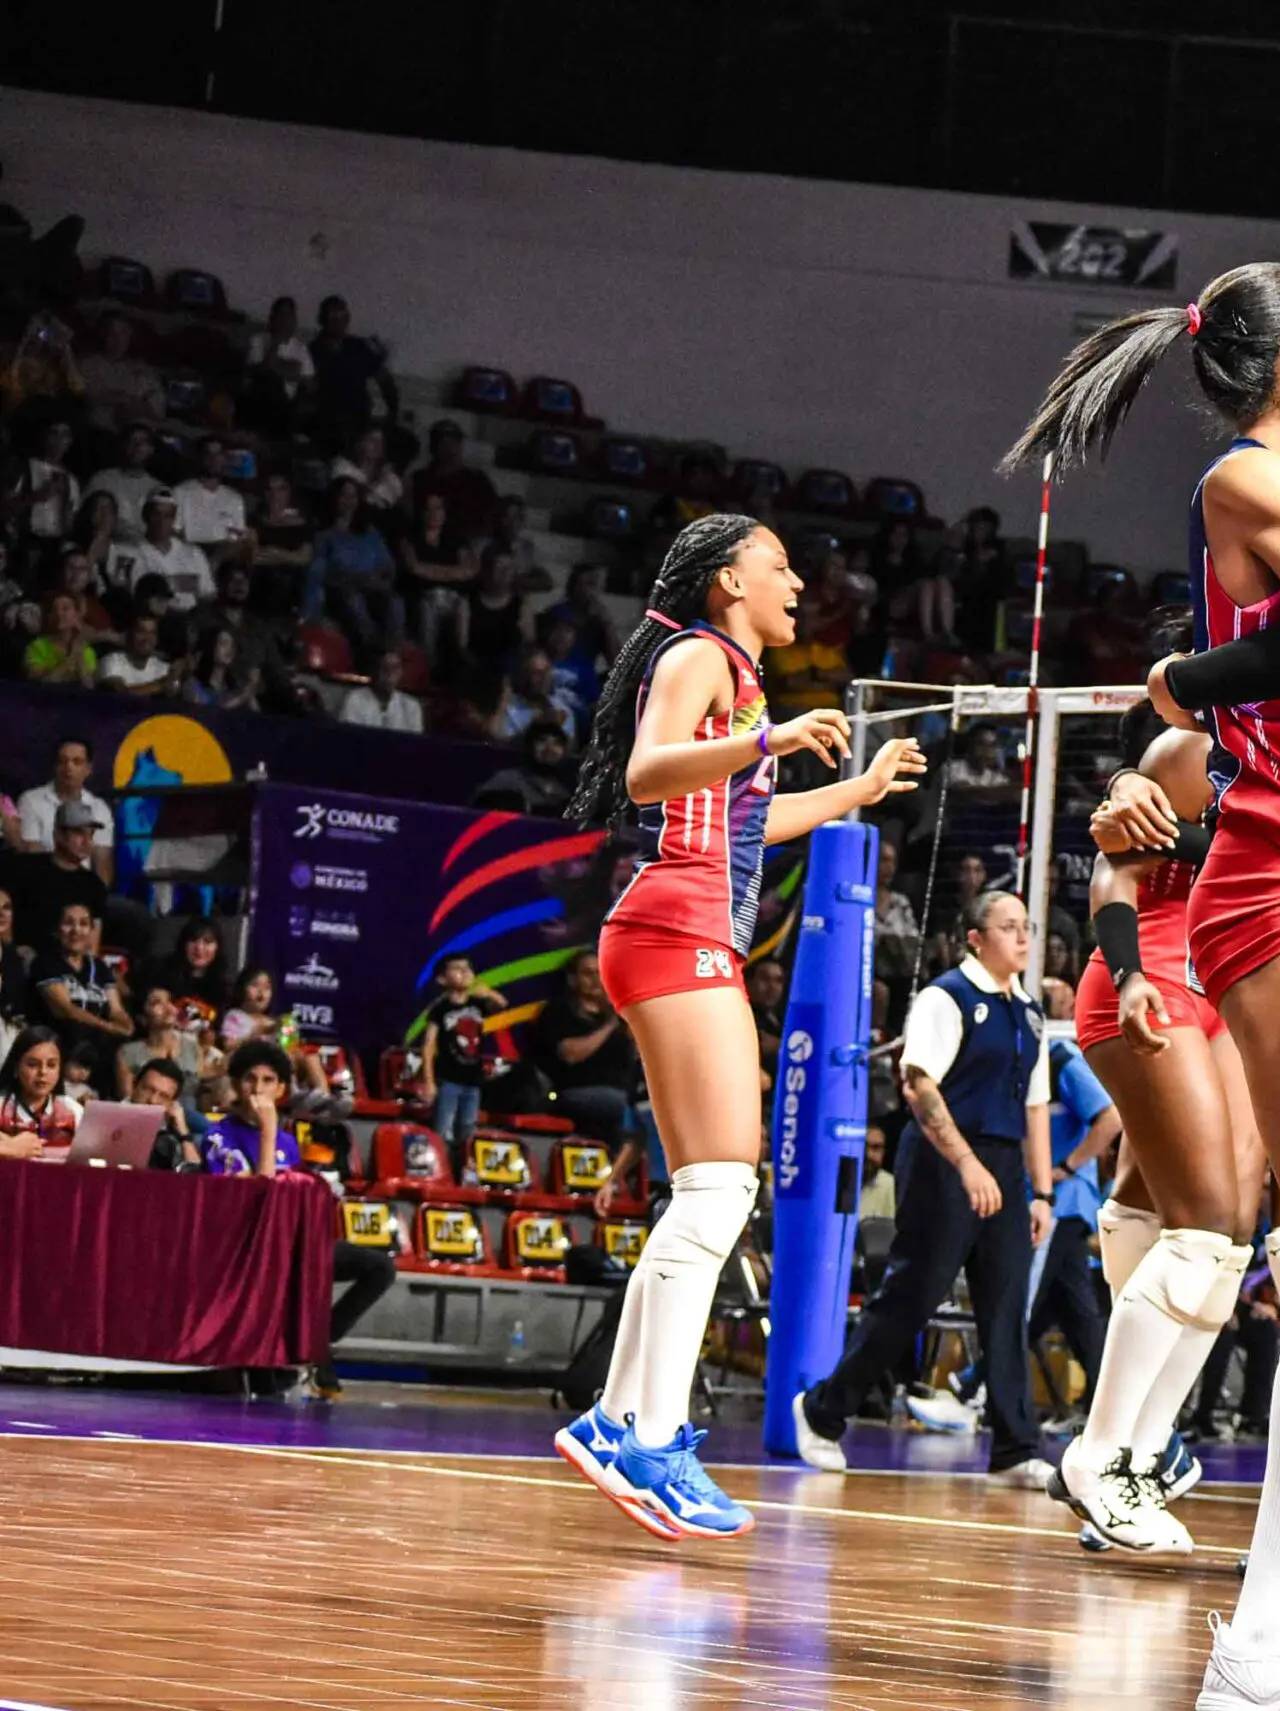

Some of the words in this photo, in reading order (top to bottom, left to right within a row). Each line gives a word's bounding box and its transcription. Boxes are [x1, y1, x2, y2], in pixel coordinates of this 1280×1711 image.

[327, 808, 400, 833] CONADE
[695, 949, 733, 979] 24
[292, 1003, 333, 1024] FIVB
[779, 1066, 806, 1189] Senoh
